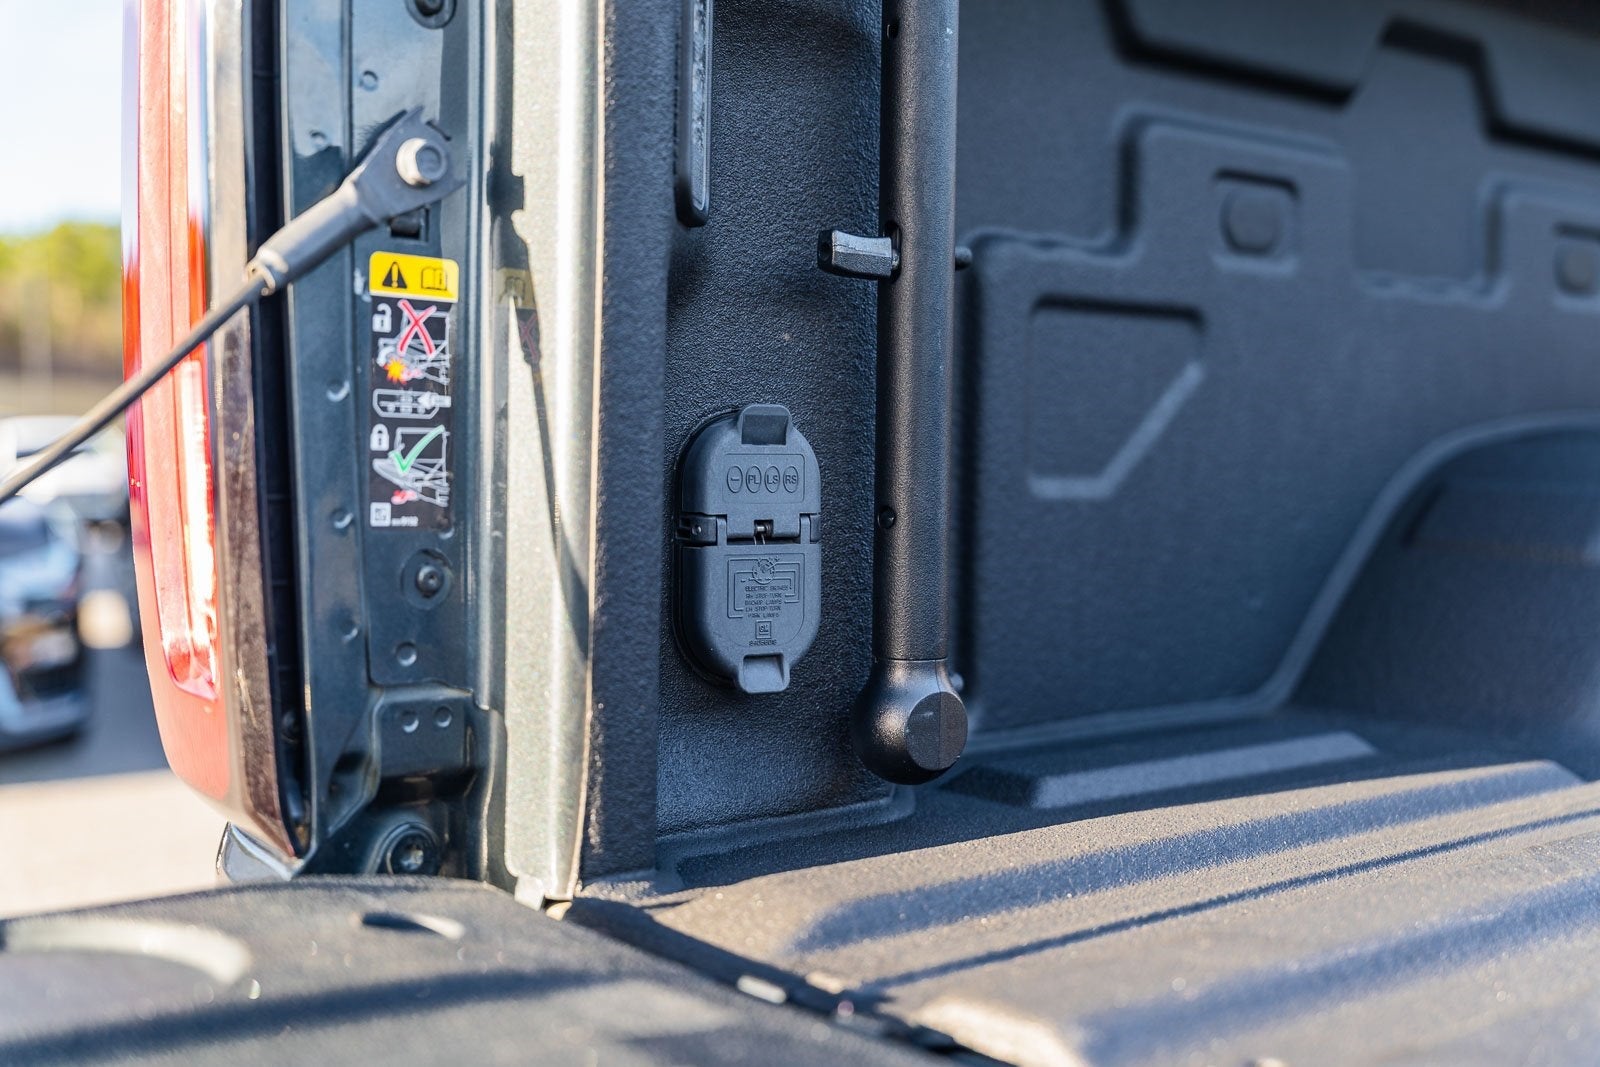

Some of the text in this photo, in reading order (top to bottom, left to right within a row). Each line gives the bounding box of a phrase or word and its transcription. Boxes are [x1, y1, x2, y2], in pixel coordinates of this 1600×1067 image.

[748, 475, 797, 485] PL LS RS
